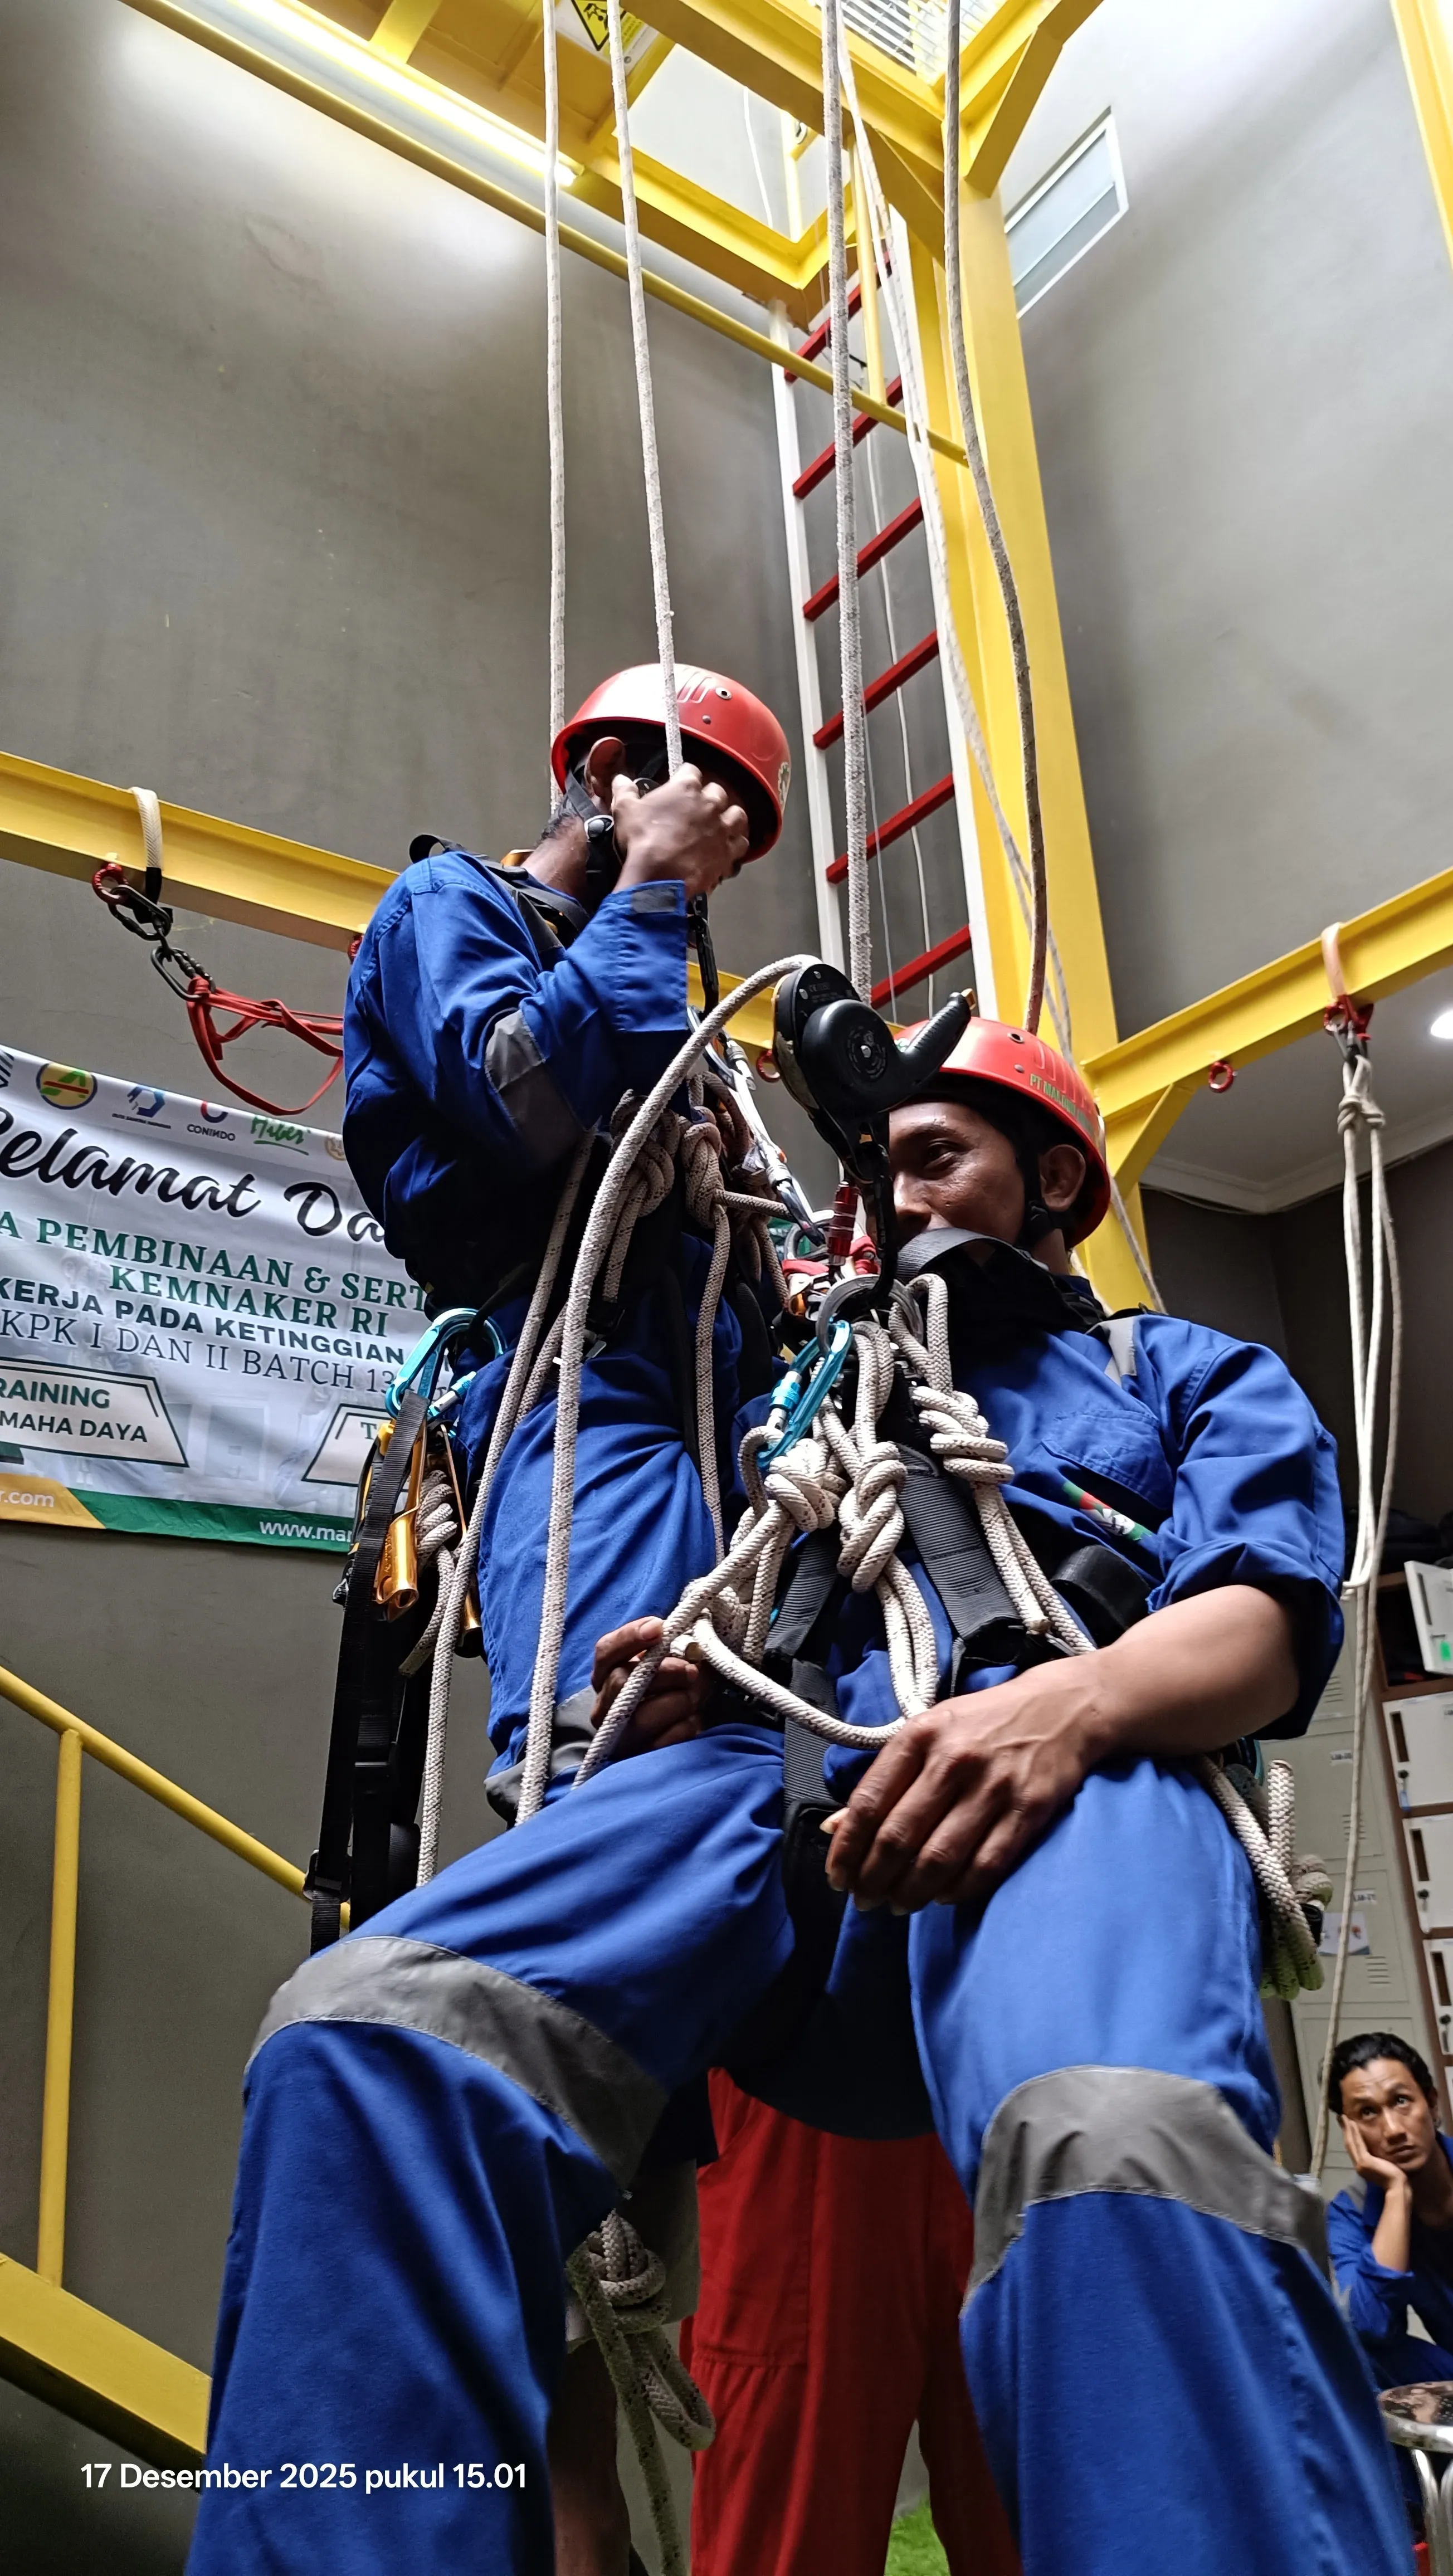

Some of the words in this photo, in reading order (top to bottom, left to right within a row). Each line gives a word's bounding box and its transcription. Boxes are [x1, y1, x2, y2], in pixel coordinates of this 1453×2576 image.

[187, 1124, 236, 1141] CONINDO
[36, 1218, 294, 1288] PEMBINAAN
[304, 1266, 331, 1294] &
[109, 1264, 338, 1329] KEMNAKER
[349, 1306, 389, 1338] RI
[115, 1300, 204, 1334] PADA
[215, 1317, 404, 1365] KETINGGIAN
[0, 1309, 77, 1345] KPK
[90, 1323, 103, 1349] I
[116, 1327, 193, 1364] DAN
[205, 1343, 230, 1371] II
[241, 1349, 355, 1389] BATCH
[0, 1410, 73, 1435] MAHA
[80, 1419, 148, 1443] DAYA
